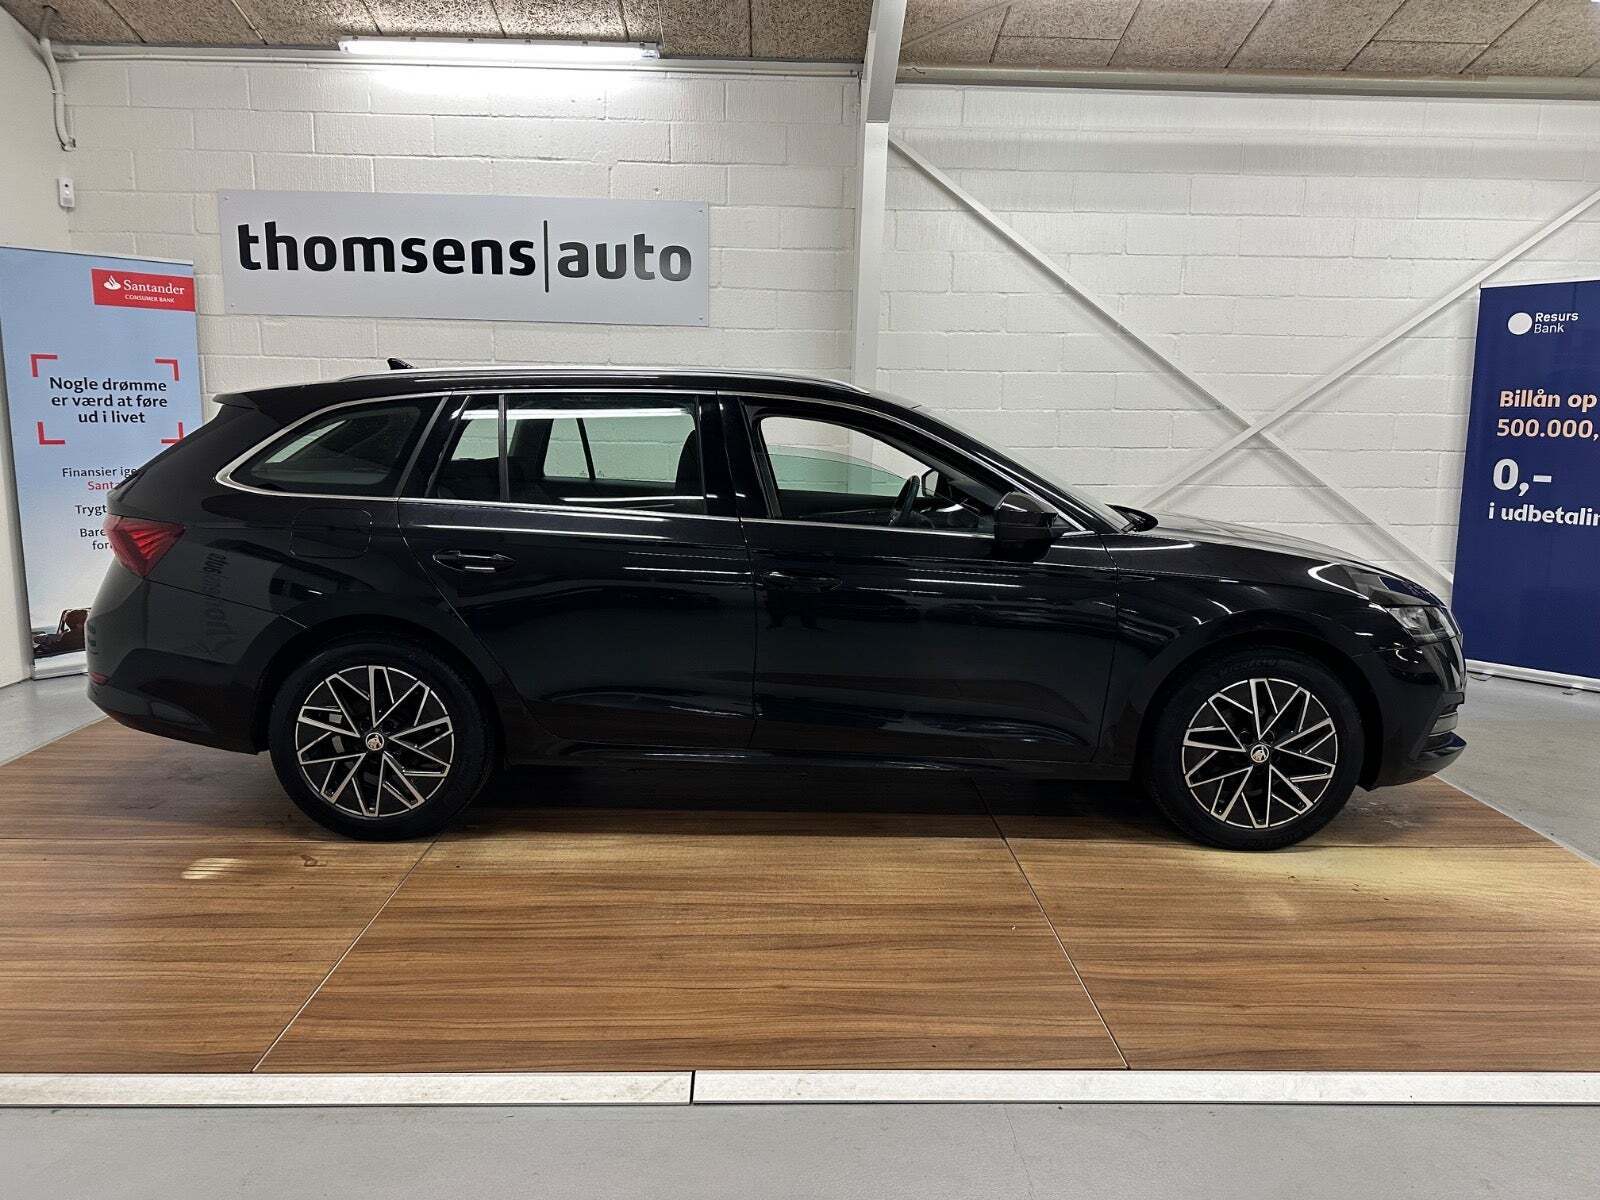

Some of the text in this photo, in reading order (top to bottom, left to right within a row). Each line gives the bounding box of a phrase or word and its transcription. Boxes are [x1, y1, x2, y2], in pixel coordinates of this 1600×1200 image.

[237, 221, 692, 282] thomsens auto
[123, 279, 185, 295] Santander
[125, 294, 159, 302] CONSUMER
[1535, 312, 1579, 323] Resurs
[1534, 323, 1565, 334] Bank
[49, 377, 167, 393] Nogle drømme
[51, 394, 168, 408] er værd at føre
[1499, 389, 1597, 412] Billån op
[78, 411, 146, 424] ud i livet
[62, 466, 118, 478] Finansier
[75, 504, 107, 516] Trygt
[1488, 502, 1495, 519] i
[92, 540, 112, 550] for
